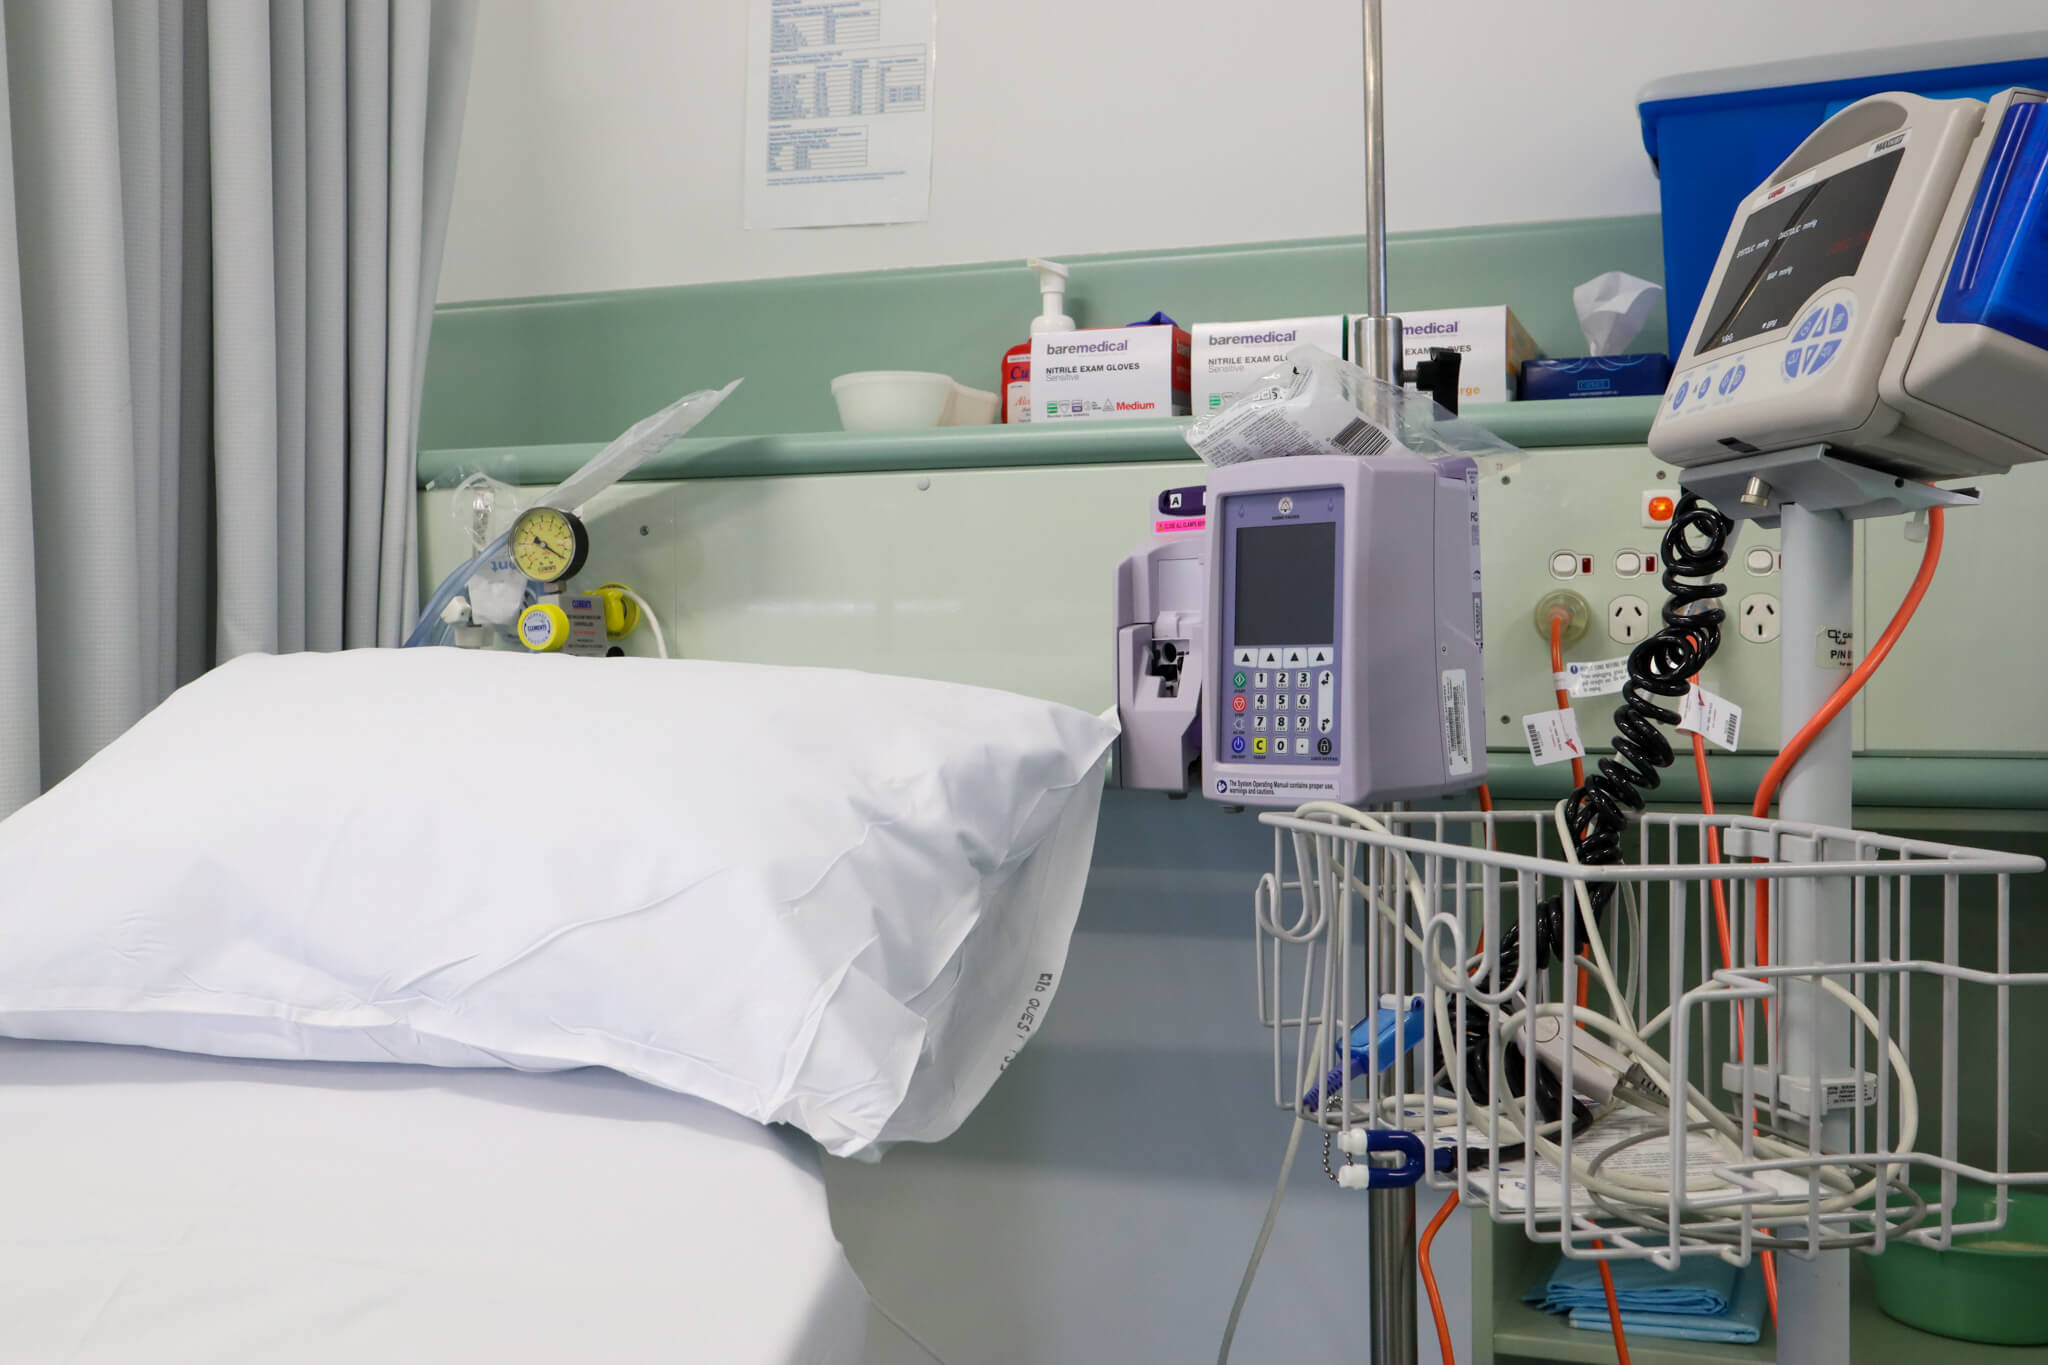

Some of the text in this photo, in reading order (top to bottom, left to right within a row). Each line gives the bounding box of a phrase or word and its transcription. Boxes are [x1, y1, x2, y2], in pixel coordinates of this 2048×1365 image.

[1402, 321, 1458, 335] medical
[1208, 330, 1296, 346] baremedical
[1047, 340, 1128, 355] baremedical
[1208, 356, 1242, 365] NITRILE
[1245, 355, 1270, 363] EXAM
[1046, 362, 1140, 374] NITRILE EXAM GLOVES
[1460, 386, 1481, 396] rge
[1116, 401, 1155, 411] Medium
[1171, 496, 1180, 506] A
[1259, 673, 1264, 683] 1
[1278, 673, 1286, 683] 2
[1300, 672, 1308, 683] 3
[1257, 695, 1264, 704] 4
[1278, 695, 1286, 705] 5
[1299, 694, 1307, 705] 6
[1257, 716, 1264, 726] 7
[1278, 716, 1285, 727] 8
[1299, 717, 1307, 727] 9
[1256, 740, 1263, 750] C
[1277, 740, 1285, 751] 0
[1237, 780, 1252, 788] System
[1253, 780, 1272, 789] Operating
